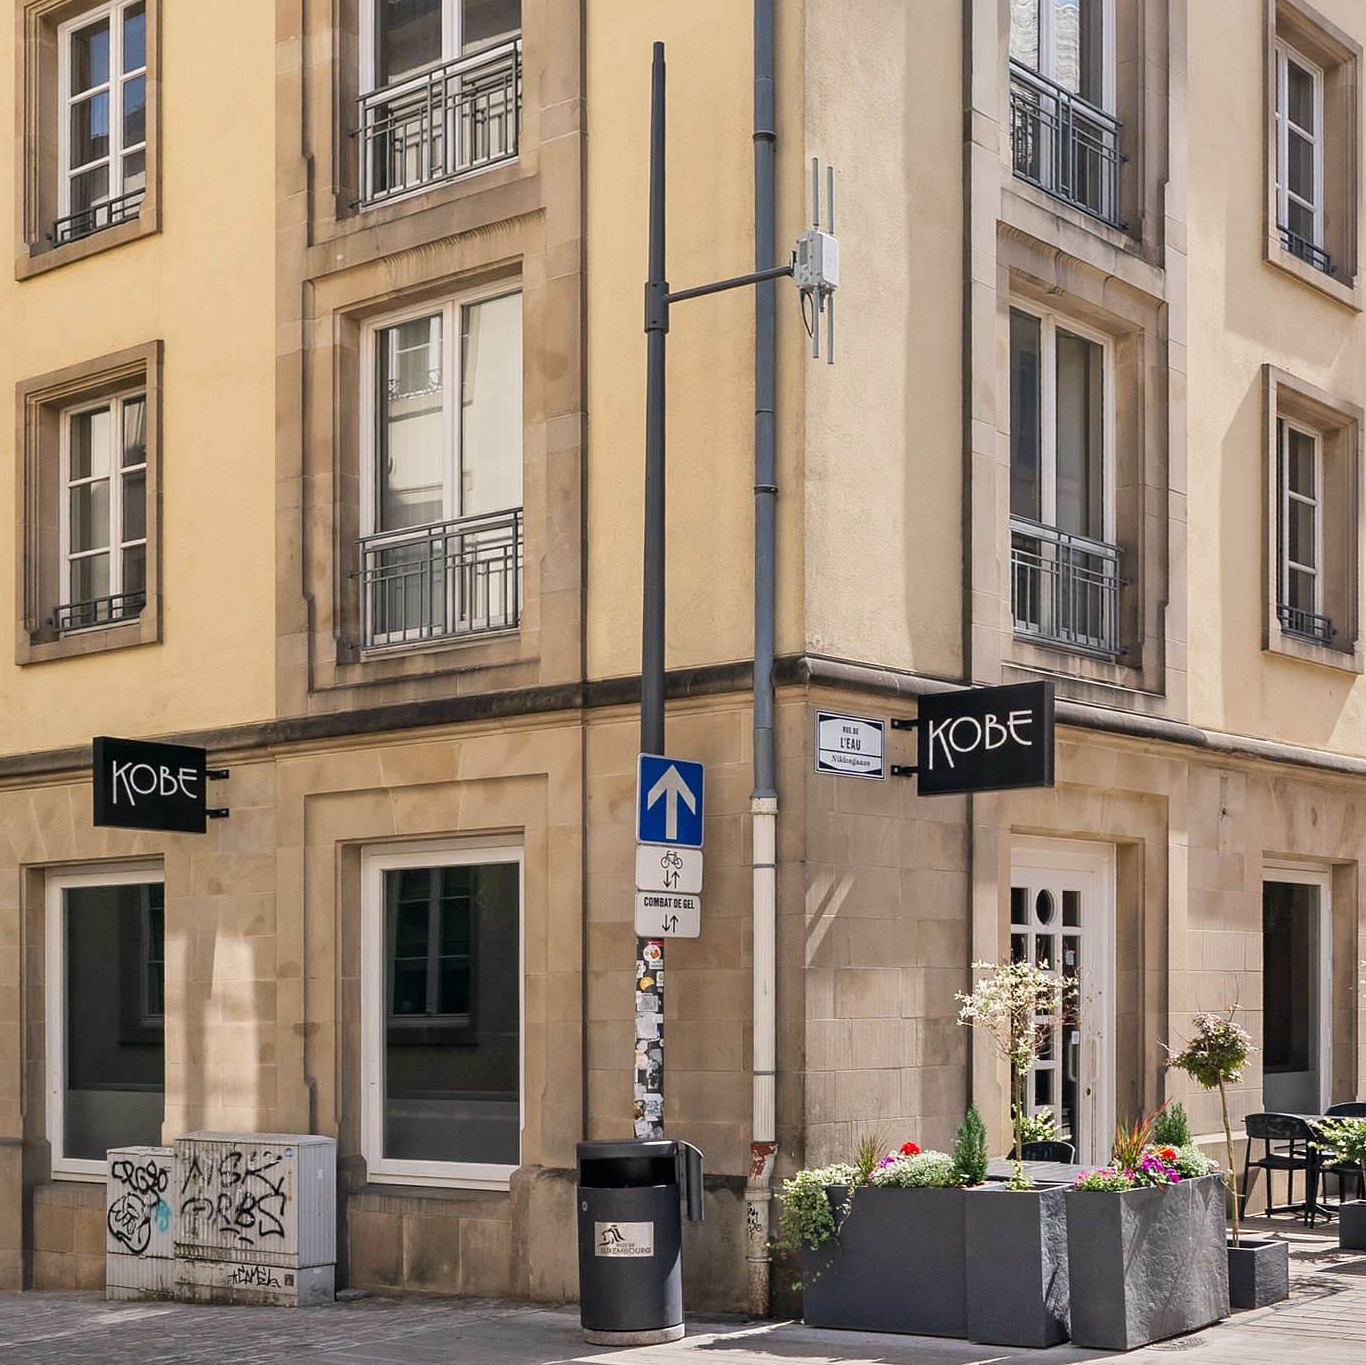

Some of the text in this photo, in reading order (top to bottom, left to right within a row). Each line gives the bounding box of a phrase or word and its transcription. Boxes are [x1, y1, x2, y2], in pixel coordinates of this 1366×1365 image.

[842, 725, 859, 735] RUE DE
[840, 736, 861, 751] L'EAU
[928, 709, 1033, 770] KOBE
[112, 760, 197, 806] KOBE
[643, 896, 695, 909] COMBAT DE GEL
